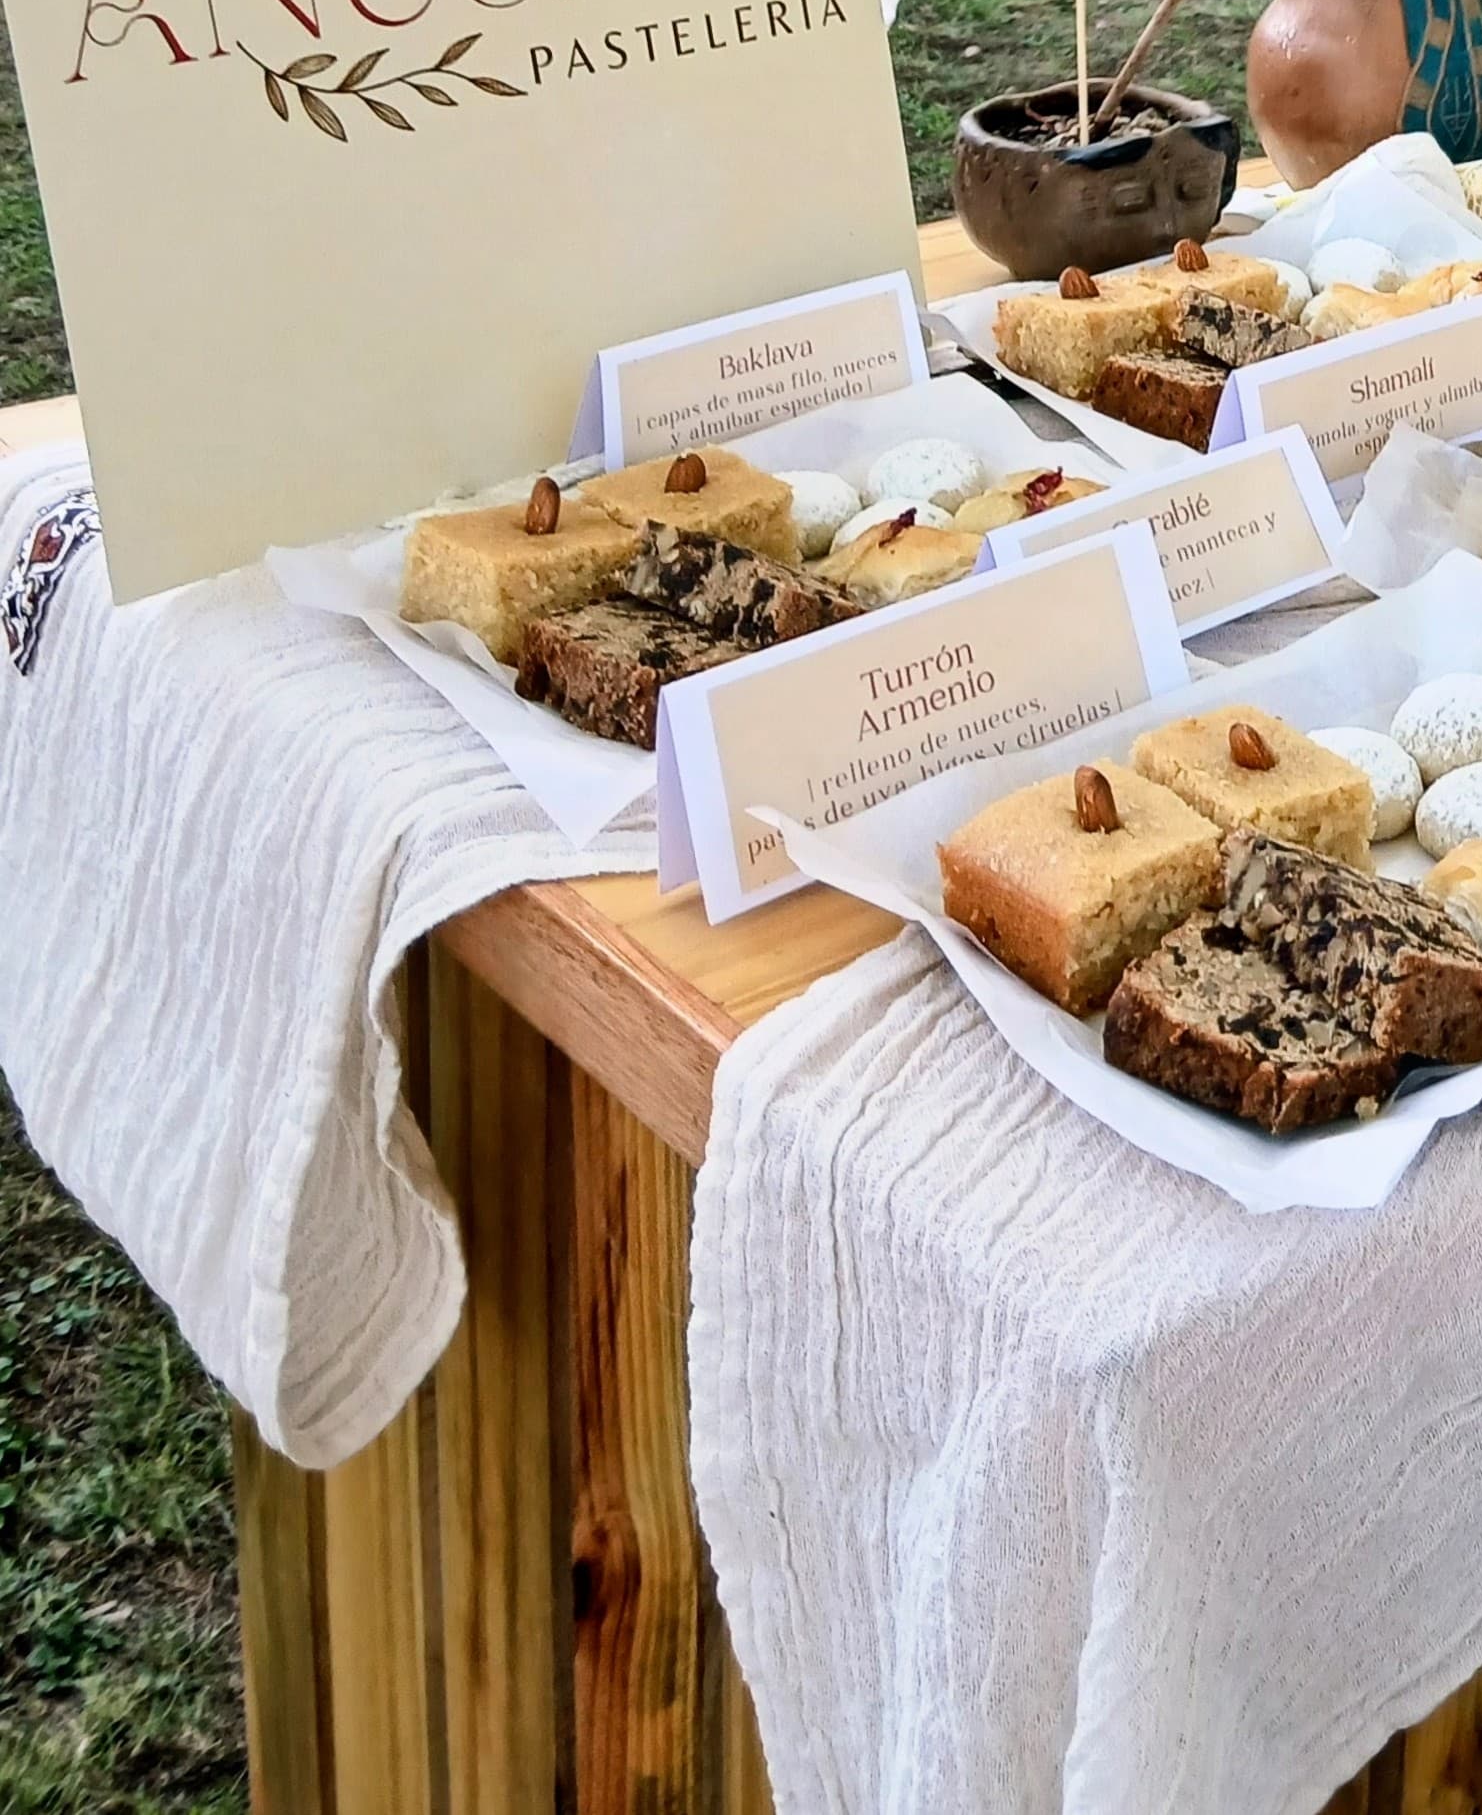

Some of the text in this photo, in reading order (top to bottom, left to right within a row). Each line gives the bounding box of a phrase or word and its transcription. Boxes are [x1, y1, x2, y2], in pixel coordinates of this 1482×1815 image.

[646, 403, 701, 430] capas
[706, 393, 730, 413] de
[737, 379, 785, 405] masa
[832, 350, 898, 379] nueces
[719, 339, 814, 380] Baklava
[1423, 396, 1433, 414] y
[1176, 521, 1261, 563] manteca
[1264, 511, 1276, 533] y
[859, 642, 975, 701] Turrón
[857, 669, 997, 743] Armenio
[821, 745, 913, 796] relleno
[920, 730, 949, 758] de
[823, 798, 854, 827] de
[1016, 699, 1112, 749] ciruelas
